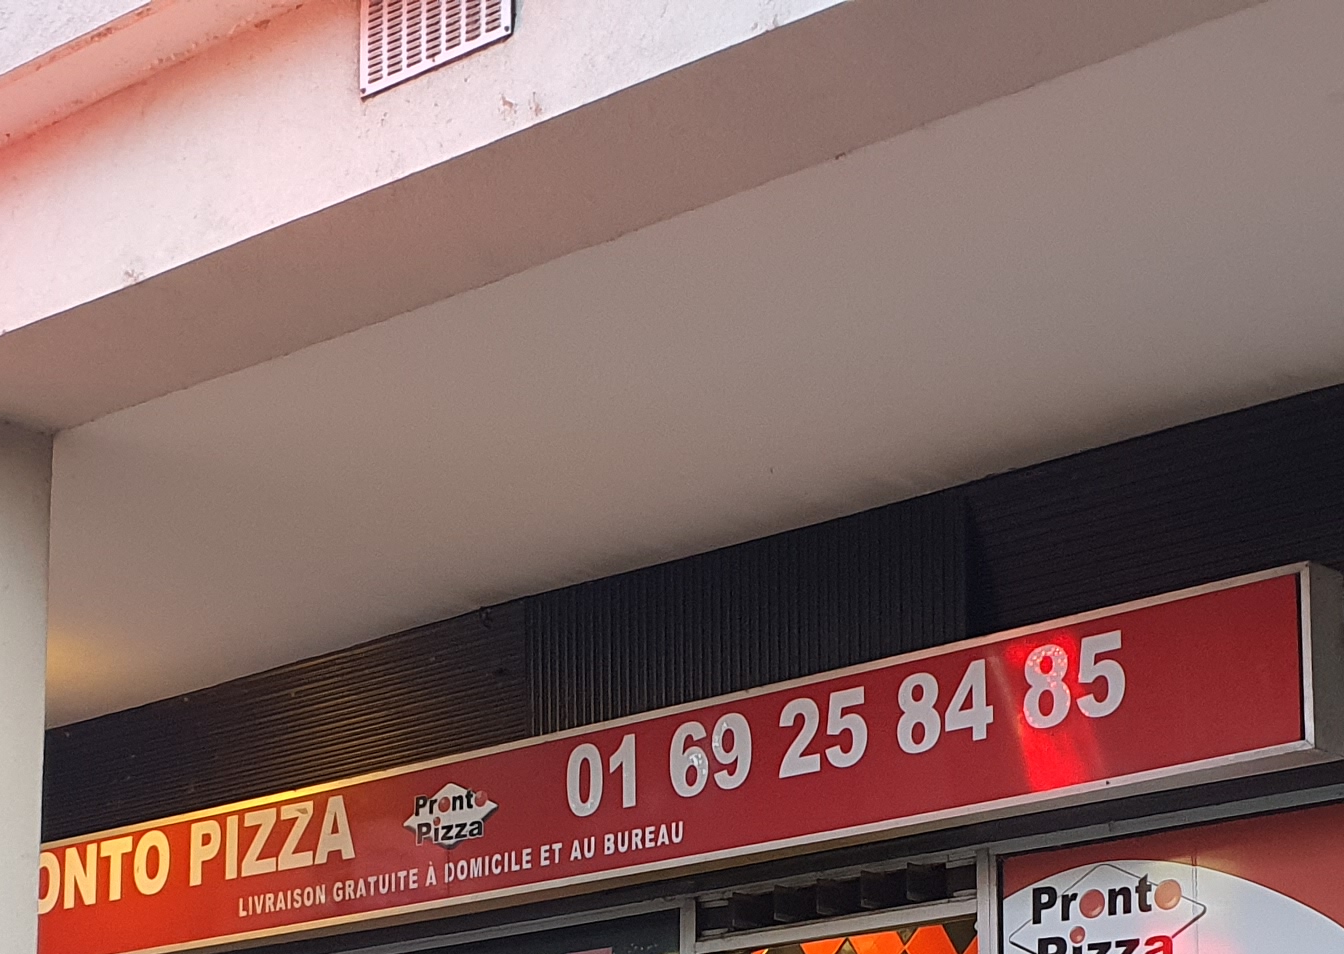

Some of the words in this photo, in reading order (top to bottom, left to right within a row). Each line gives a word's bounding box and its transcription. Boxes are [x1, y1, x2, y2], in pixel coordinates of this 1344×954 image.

[566, 732, 637, 818] 01
[668, 711, 753, 798] 69
[778, 686, 868, 779] 25
[896, 658, 994, 756] 84
[1022, 629, 1127, 728] 85
[414, 788, 488, 817] Pronto
[416, 816, 483, 845] Pizza
[189, 794, 355, 887] PIZZA
[238, 883, 326, 917] LIVRAISON
[333, 868, 419, 903] GRATUITE
[425, 861, 438, 886] À
[444, 848, 532, 883] DOMICILE
[540, 842, 562, 867] ET
[570, 836, 595, 861] AU
[604, 821, 684, 855] BUREAU
[1031, 874, 1182, 924] Pronto
